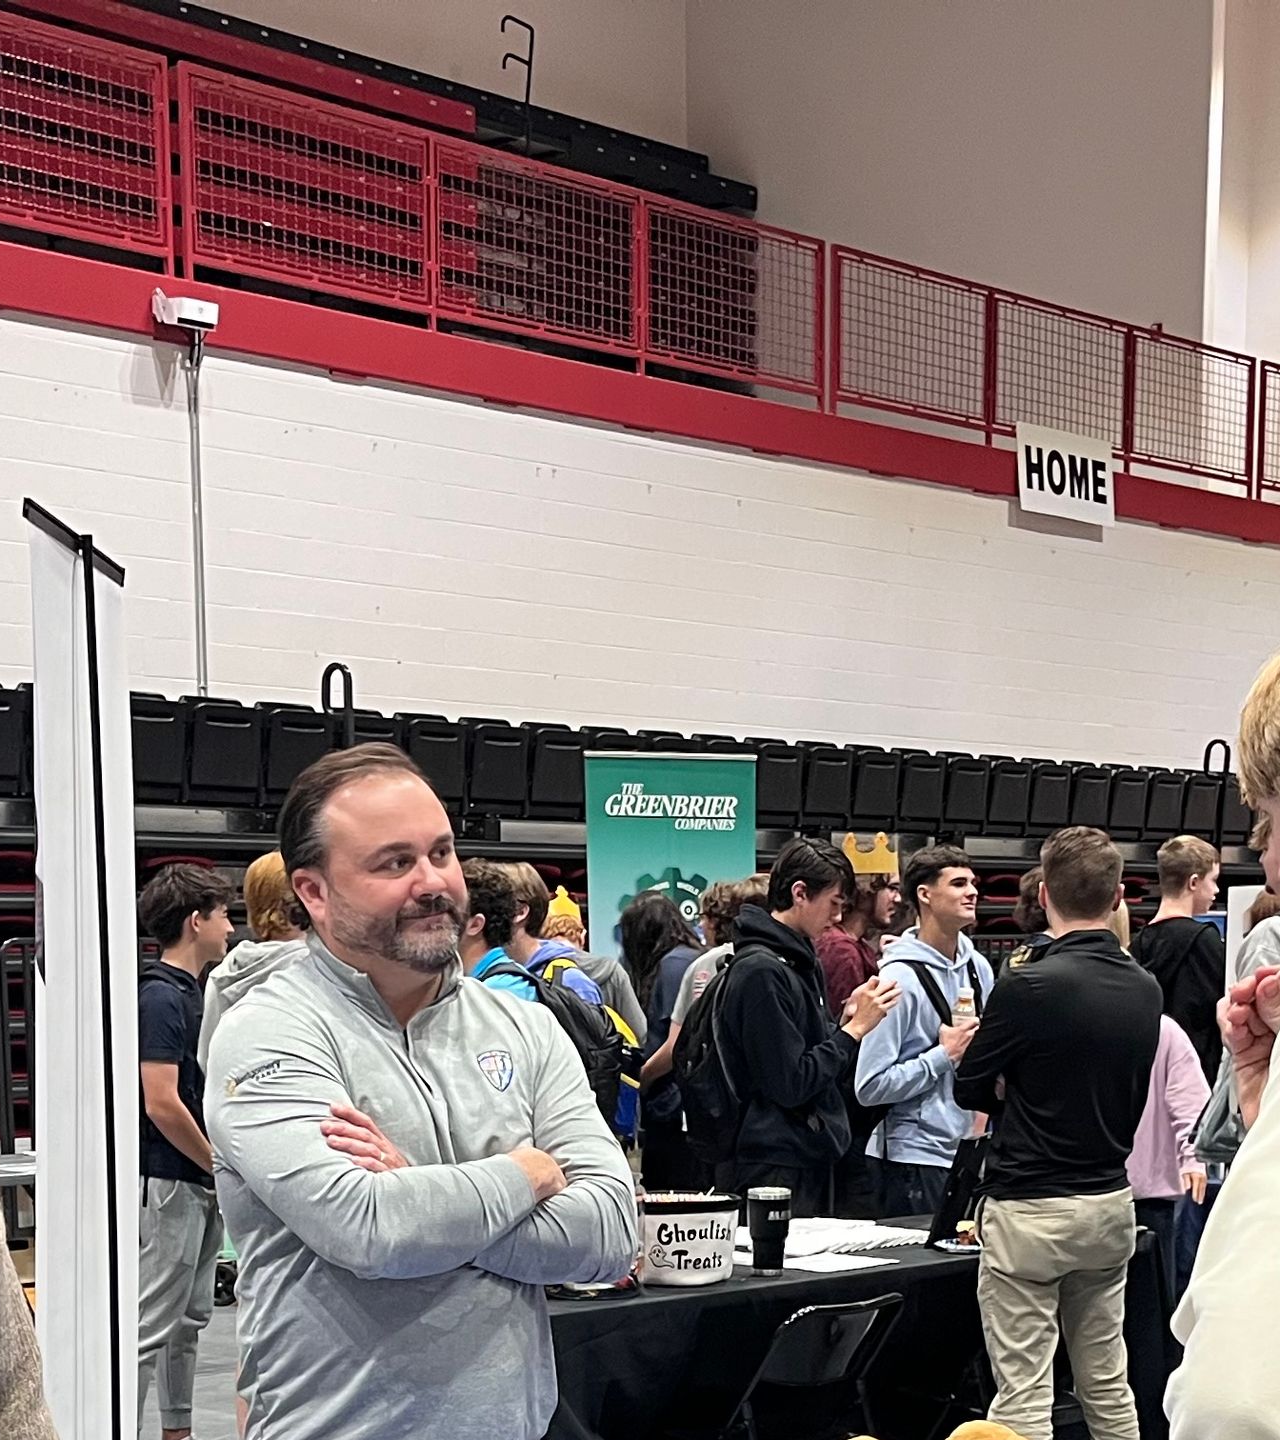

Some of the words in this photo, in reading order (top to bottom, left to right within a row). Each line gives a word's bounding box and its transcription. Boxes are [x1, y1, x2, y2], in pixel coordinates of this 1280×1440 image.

[1025, 444, 1108, 505] HOME
[621, 783, 644, 796] THE
[604, 793, 739, 819] GREENBRIER
[674, 818, 736, 831] COMPANIES
[672, 1250, 723, 1271] Treats
